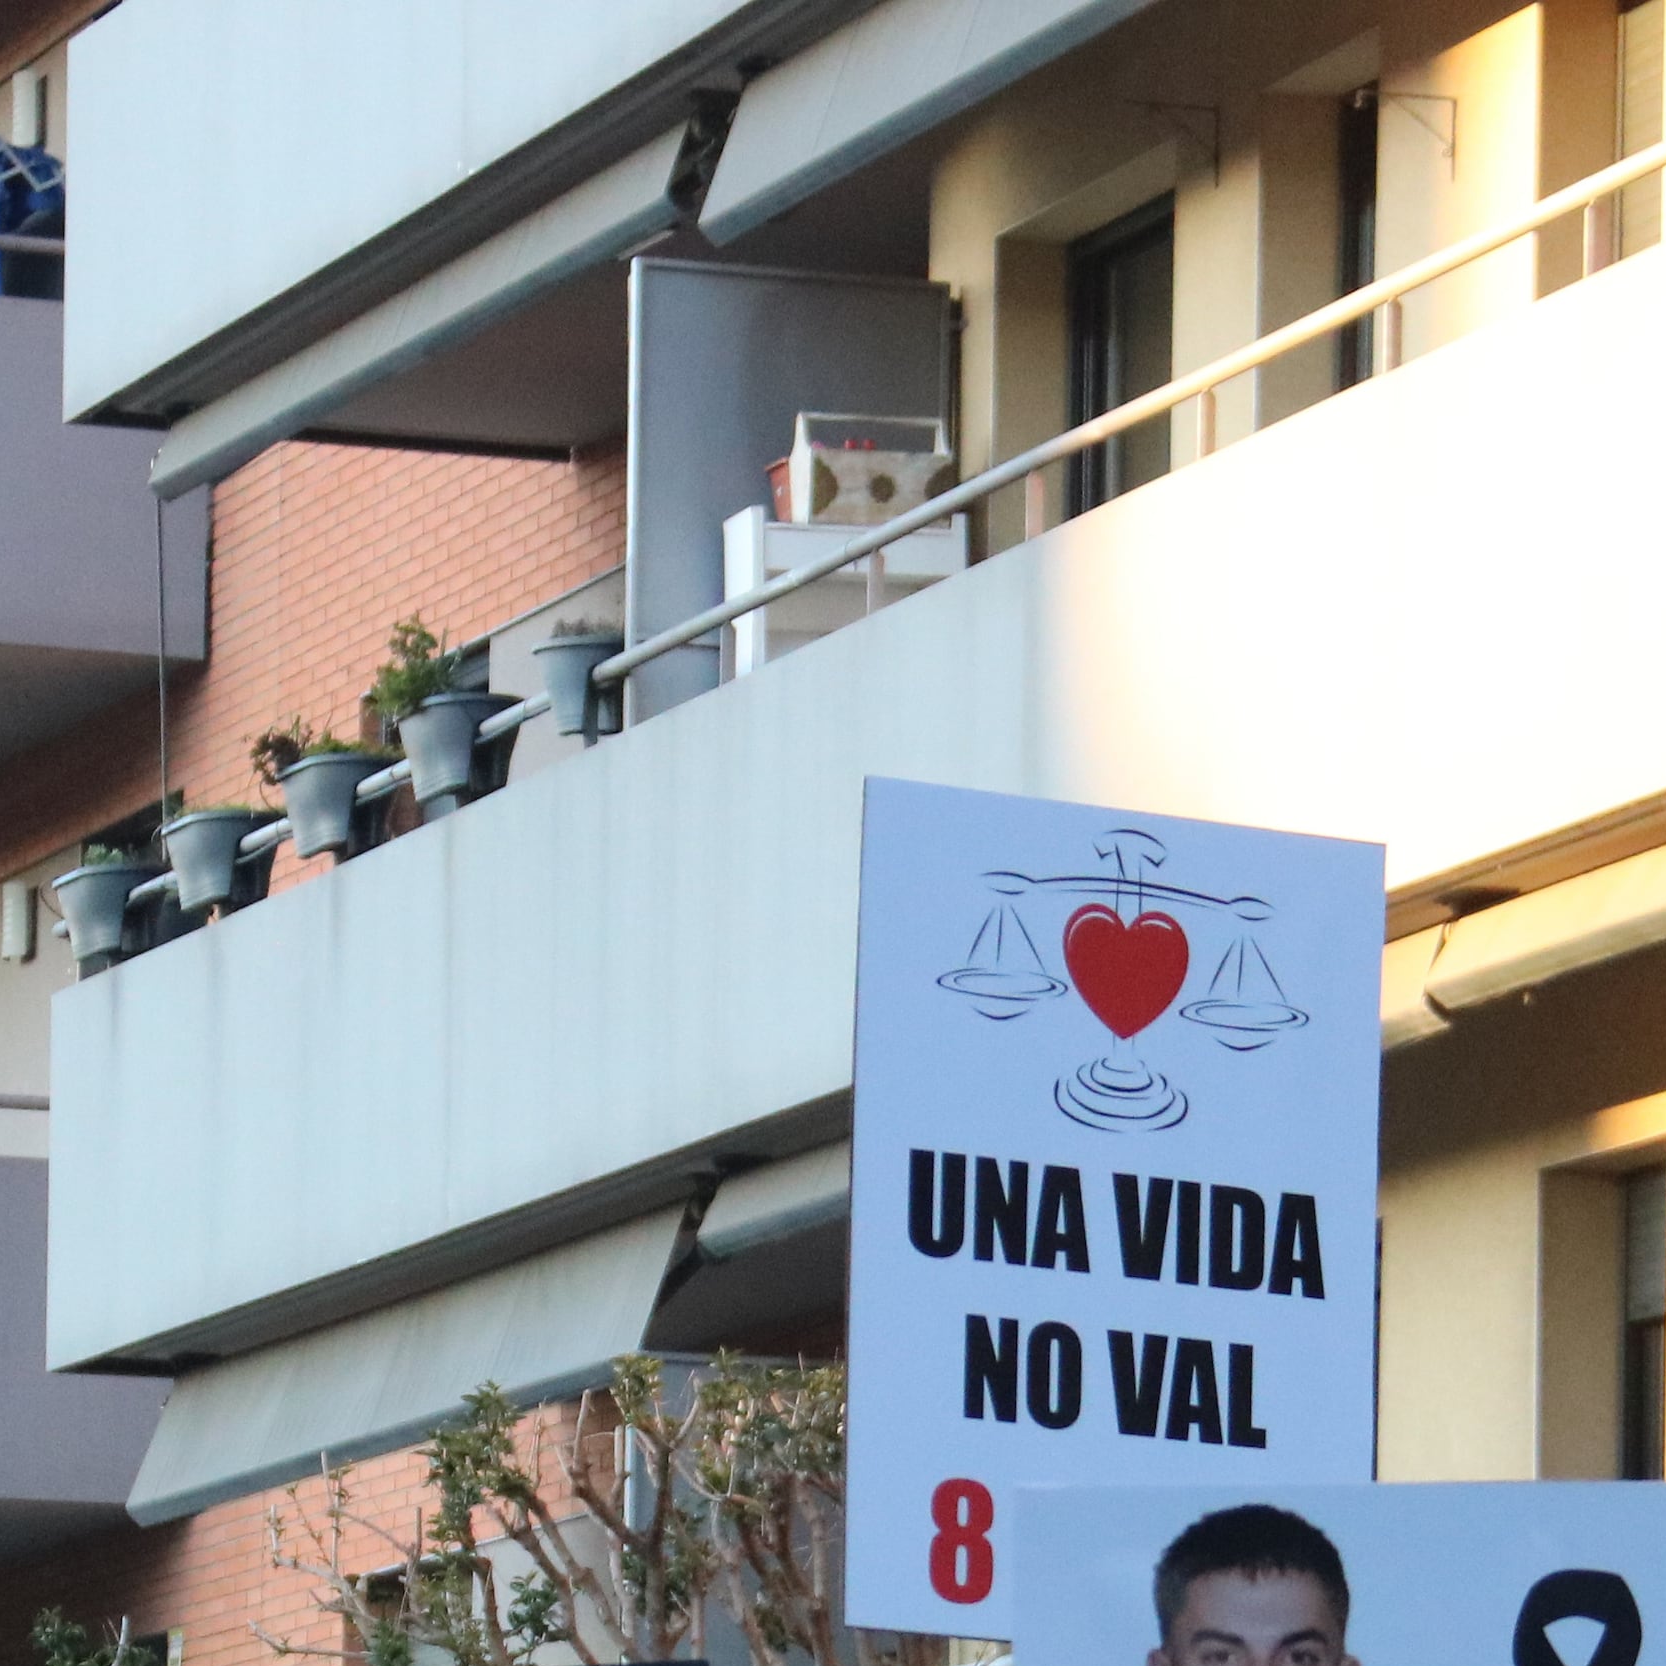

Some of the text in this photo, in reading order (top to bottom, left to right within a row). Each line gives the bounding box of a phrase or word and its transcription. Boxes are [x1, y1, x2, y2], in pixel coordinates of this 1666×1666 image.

[907, 1149, 1325, 1300] UNA VIDA
[964, 1313, 1268, 1449] NO VAL
[928, 1477, 995, 1604] 8
